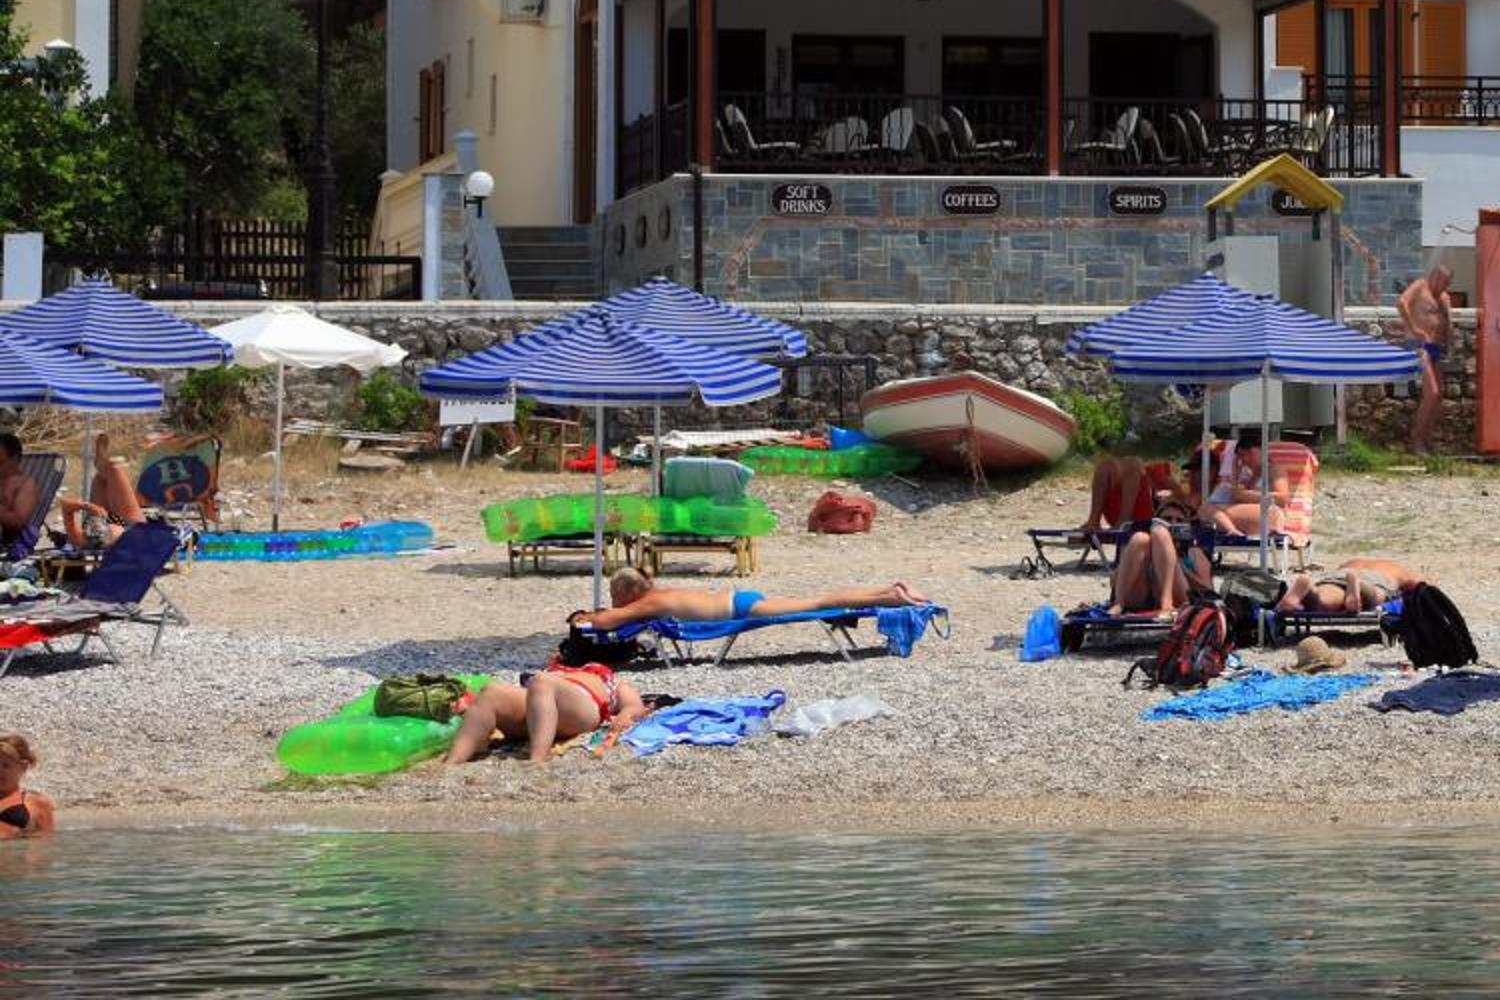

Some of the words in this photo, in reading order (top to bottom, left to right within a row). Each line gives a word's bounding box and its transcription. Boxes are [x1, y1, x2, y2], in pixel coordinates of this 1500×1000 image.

[786, 185, 817, 199] SOFT
[780, 199, 826, 213] DRINKS
[945, 193, 998, 207] COFFEES
[1115, 194, 1162, 208] SPIRITS
